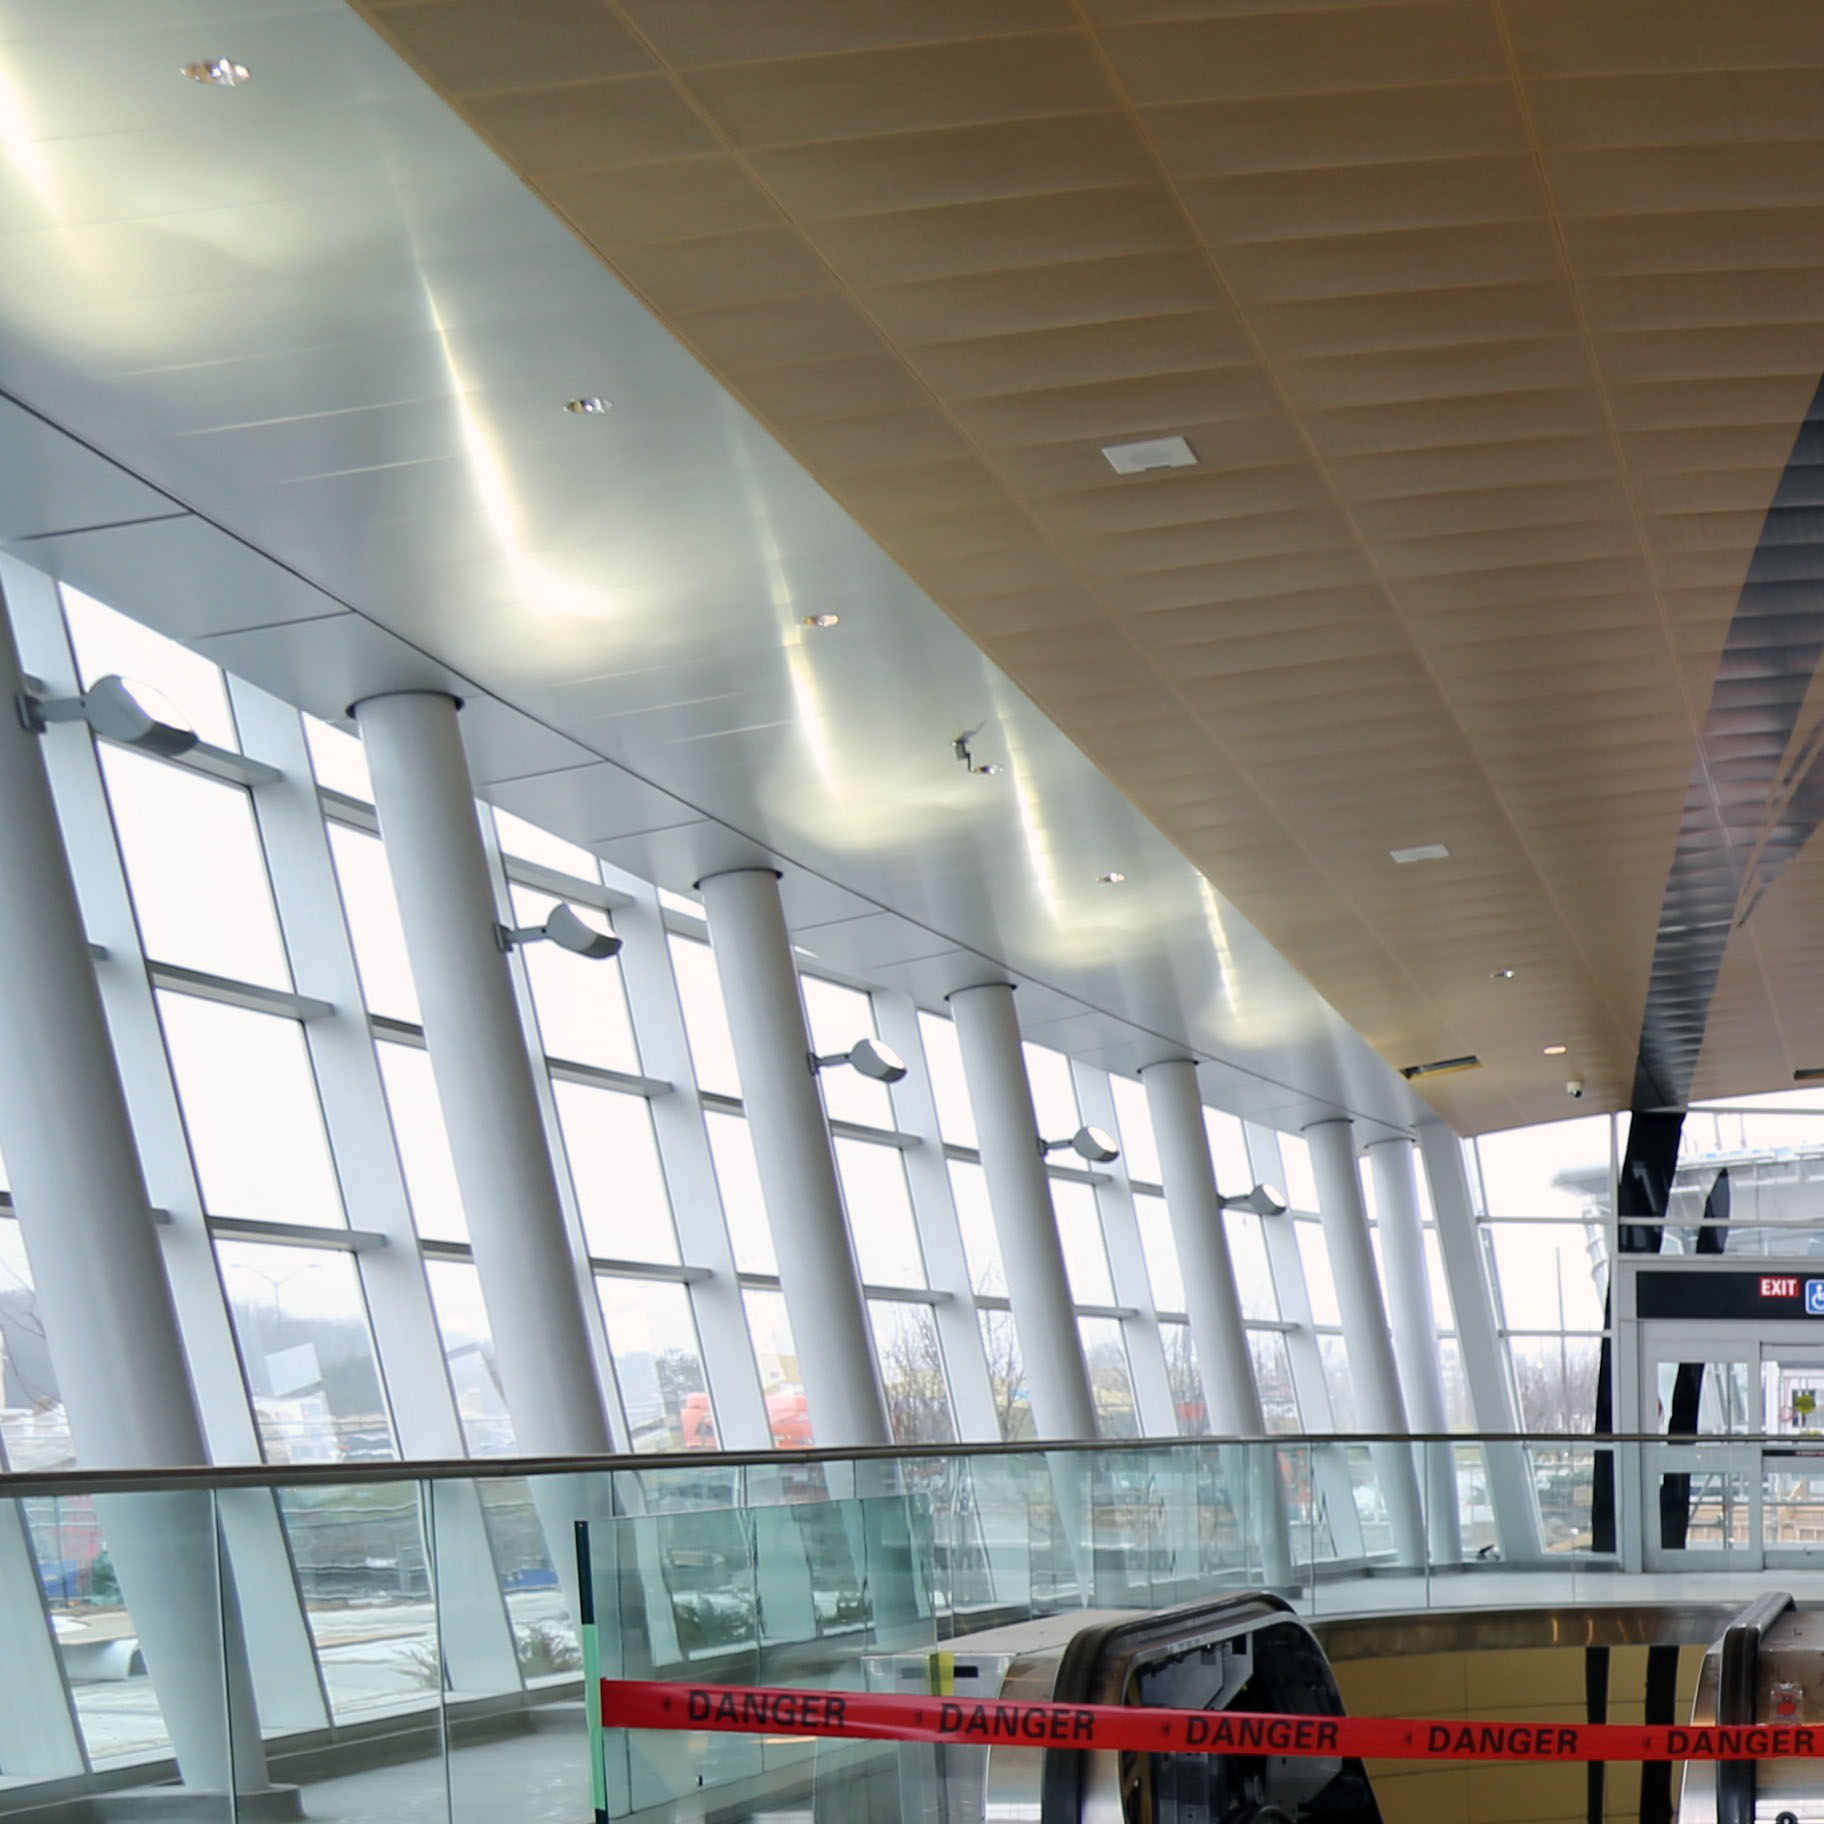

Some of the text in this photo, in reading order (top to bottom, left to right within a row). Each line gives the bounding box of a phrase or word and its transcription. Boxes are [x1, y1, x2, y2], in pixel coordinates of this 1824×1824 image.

[1761, 1279, 1797, 1296] EXIT
[687, 1690, 846, 1729] DANGER
[940, 1702, 1096, 1741] DANGER
[1186, 1715, 1339, 1750] DANGER
[1426, 1725, 1579, 1756] DANGER
[1666, 1729, 1815, 1756] DANGER
